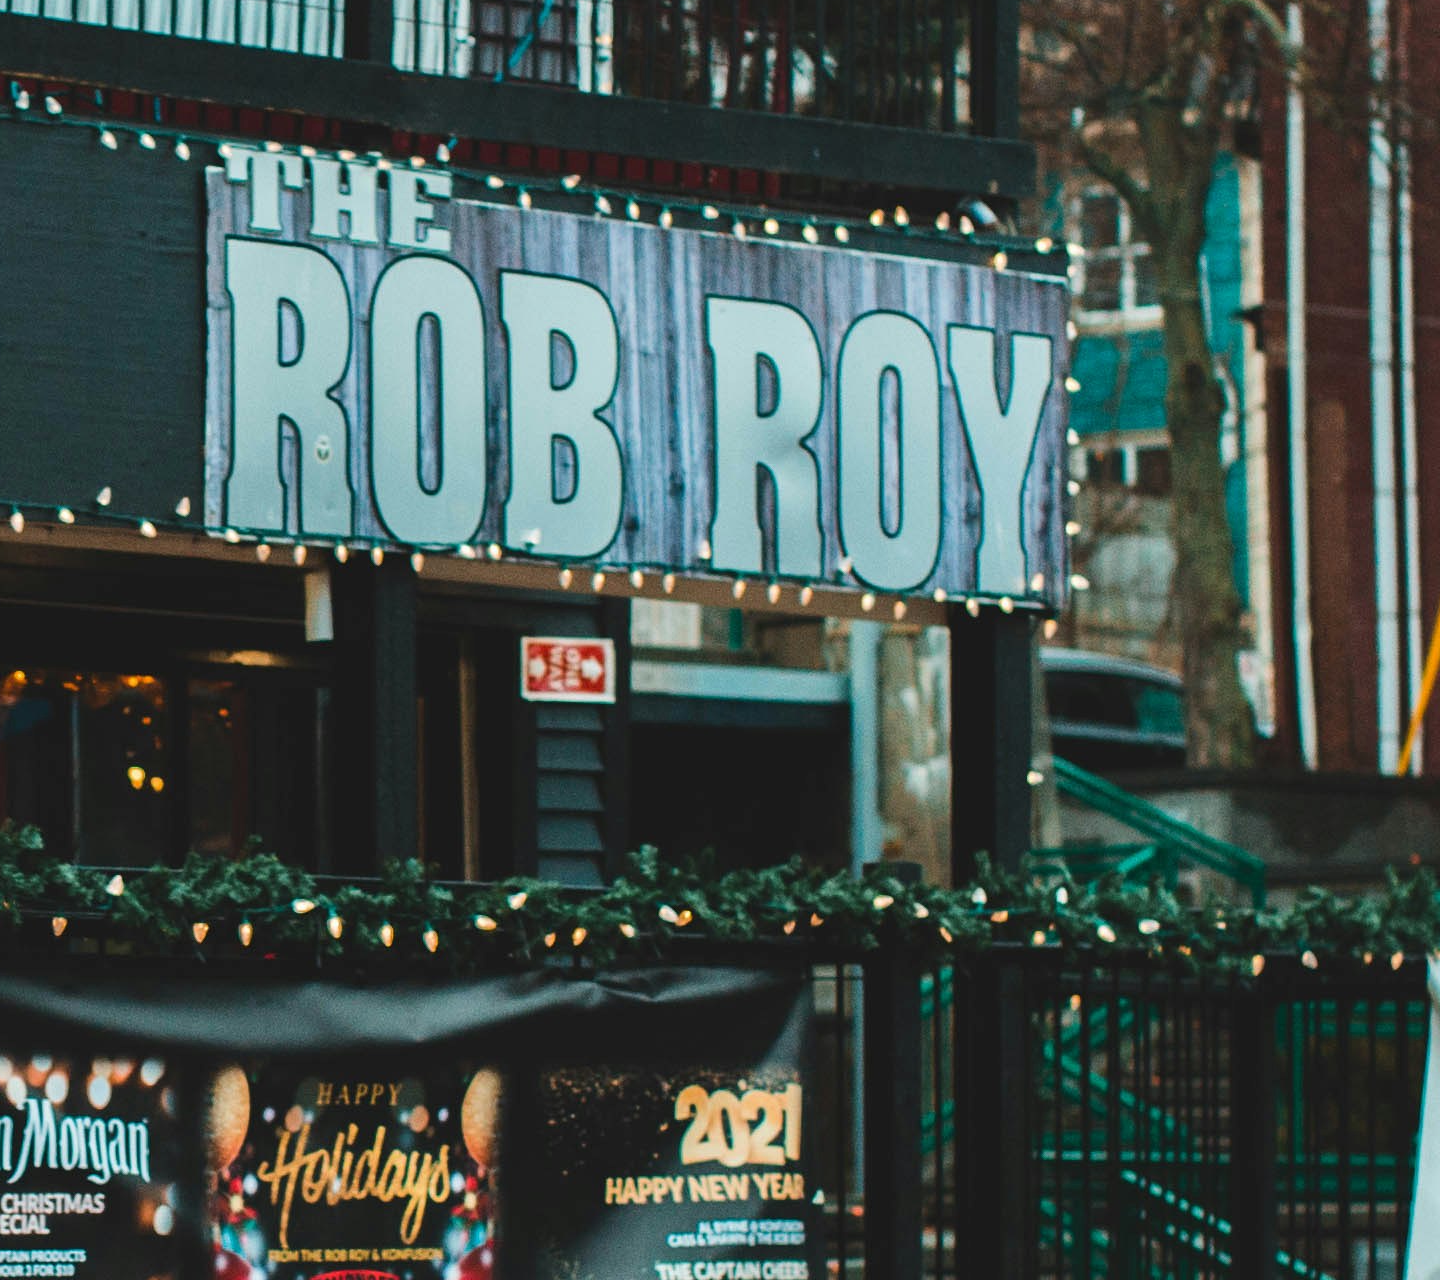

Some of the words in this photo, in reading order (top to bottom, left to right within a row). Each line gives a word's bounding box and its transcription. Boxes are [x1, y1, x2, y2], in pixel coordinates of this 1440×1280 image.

[222, 142, 455, 253] THE
[224, 234, 623, 559] ROB
[705, 294, 1053, 596] ROY
[316, 1082, 404, 1106] HAPPY
[674, 1082, 803, 1168] 2021
[7, 1098, 151, 1185] Morgan
[257, 1121, 450, 1250] Holidays
[605, 1175, 685, 1205] HAPPY
[686, 1174, 750, 1202] NEW
[751, 1172, 805, 1200] YEAR
[1, 1193, 106, 1214] CHRISTMAS
[31, 1249, 87, 1262] PRODUCTS
[268, 1248, 299, 1262] FROM
[301, 1248, 323, 1262] THE
[325, 1248, 348, 1261] ROB
[349, 1248, 370, 1261] ROY
[34, 1264, 55, 1276] FOR
[694, 1261, 761, 1280] CAPTAIN
[762, 1261, 809, 1280] CHEERS
